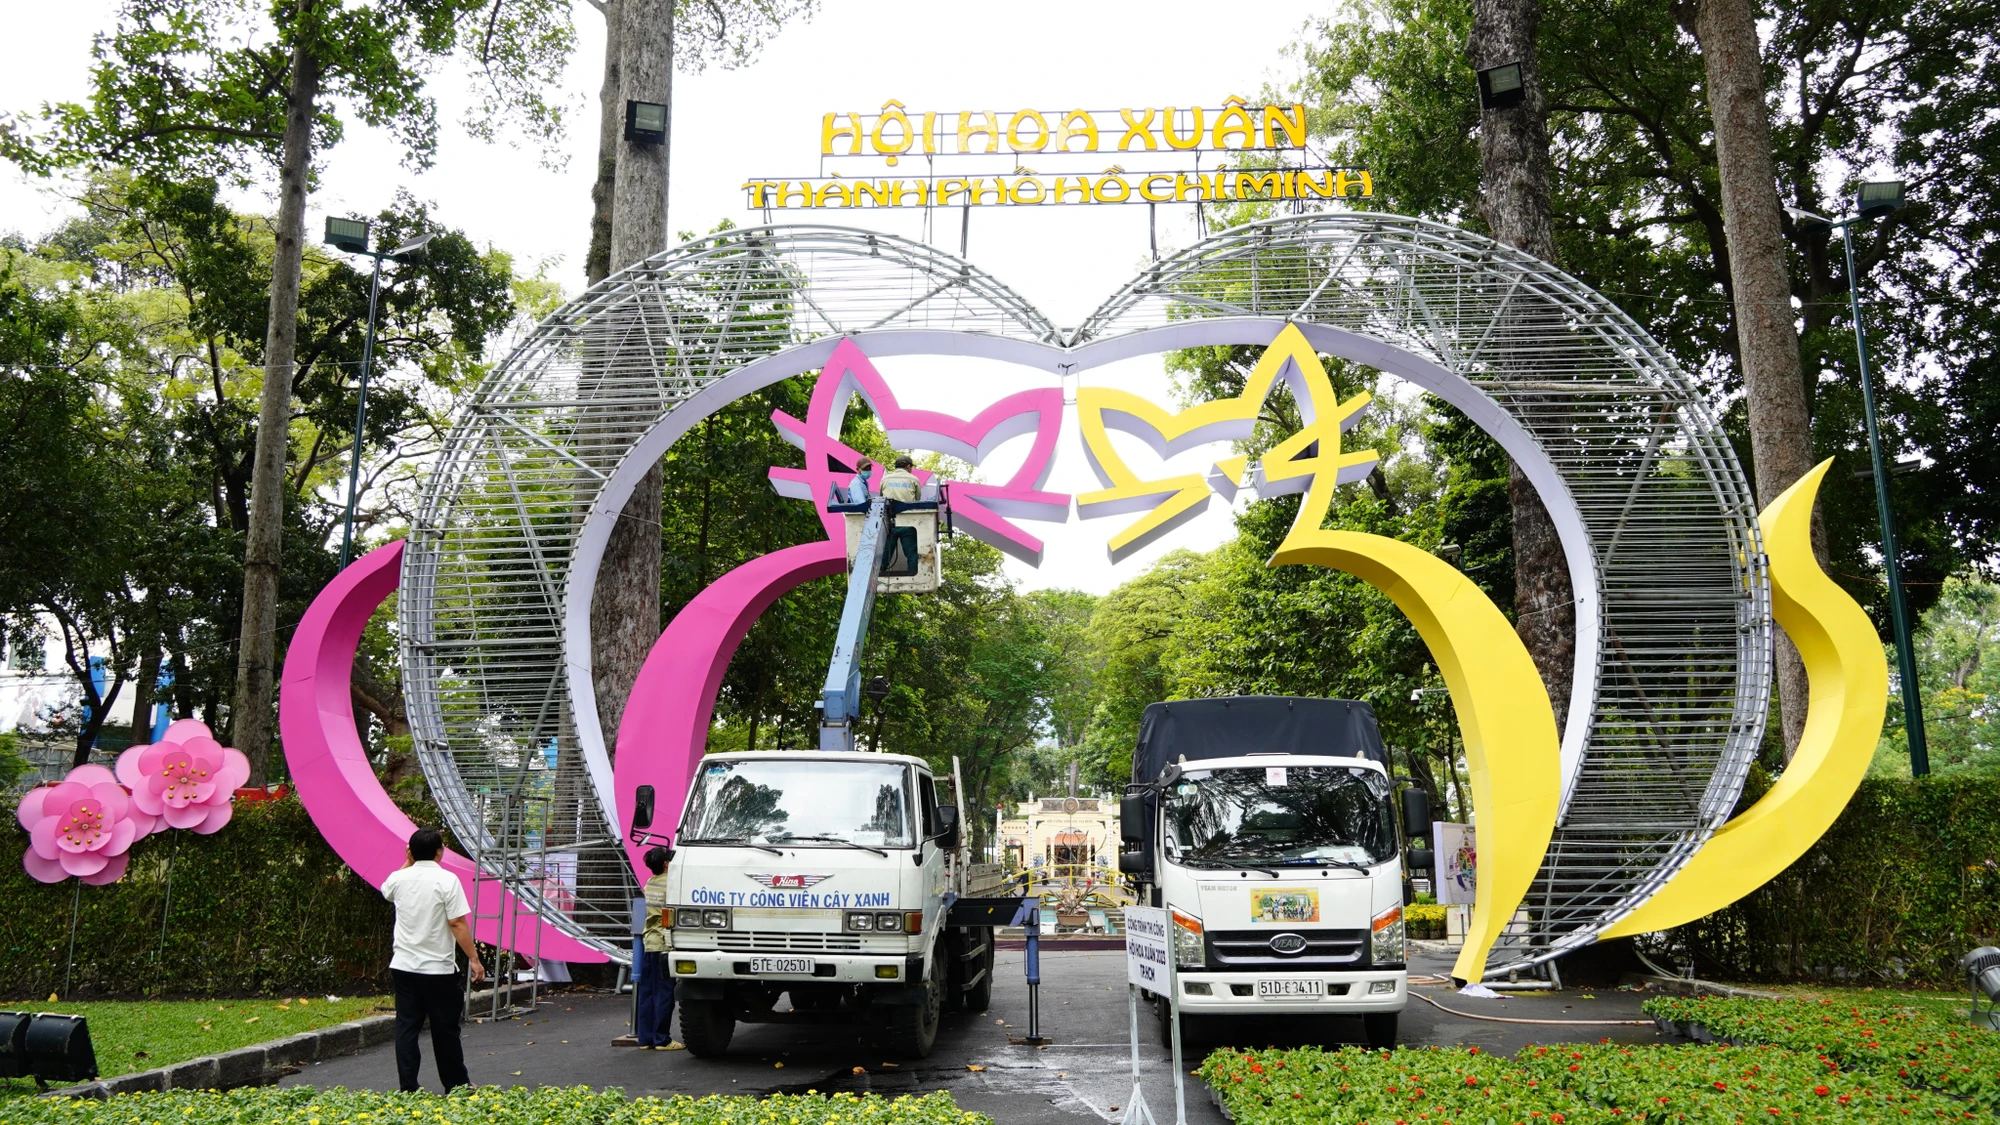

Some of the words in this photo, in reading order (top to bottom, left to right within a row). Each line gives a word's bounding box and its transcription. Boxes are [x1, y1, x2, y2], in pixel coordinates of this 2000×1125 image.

[821, 98, 937, 167] HỘI
[957, 108, 1100, 153] HOA
[1118, 95, 1307, 152] XUÂN
[741, 172, 928, 208] THÀNH
[1054, 164, 1131, 204] HỒ
[1139, 164, 1227, 202] CHÍ
[1235, 170, 1373, 200] MINH
[691, 886, 725, 905] CÔNG
[729, 892, 746, 905] TY
[750, 889, 785, 907] CÔNG
[789, 890, 819, 908] VIÊN
[823, 890, 850, 907] CÂY
[854, 892, 890, 907] XANH
[1274, 939, 1302, 948] VEAM
